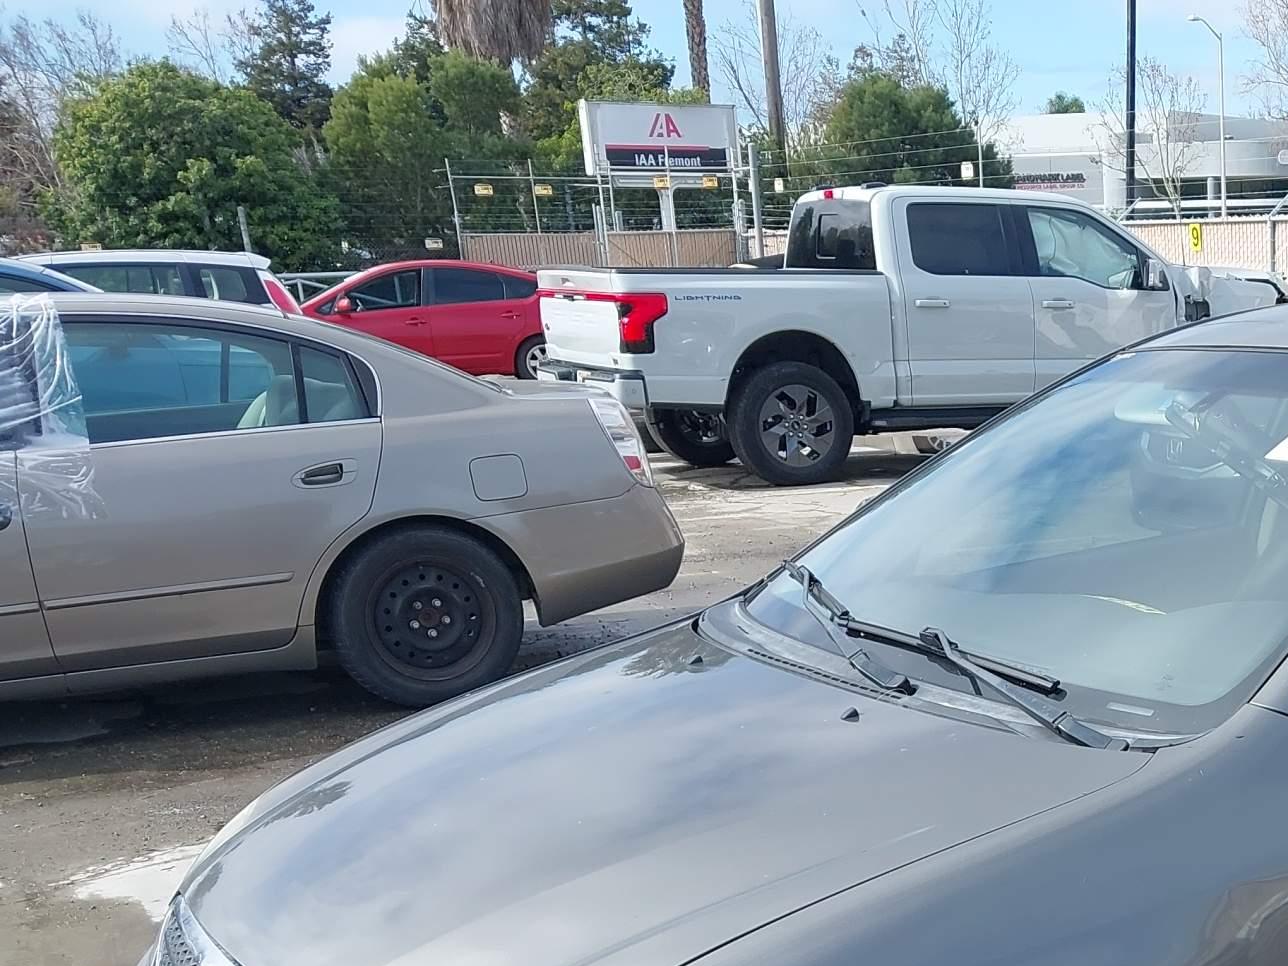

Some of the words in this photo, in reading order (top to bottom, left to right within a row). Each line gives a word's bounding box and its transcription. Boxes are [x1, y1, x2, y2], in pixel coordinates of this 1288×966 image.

[635, 153, 656, 166] IAA
[658, 154, 701, 167] Femont
[1013, 174, 1061, 184] ANDMARK
[1192, 226, 1199, 246] 9
